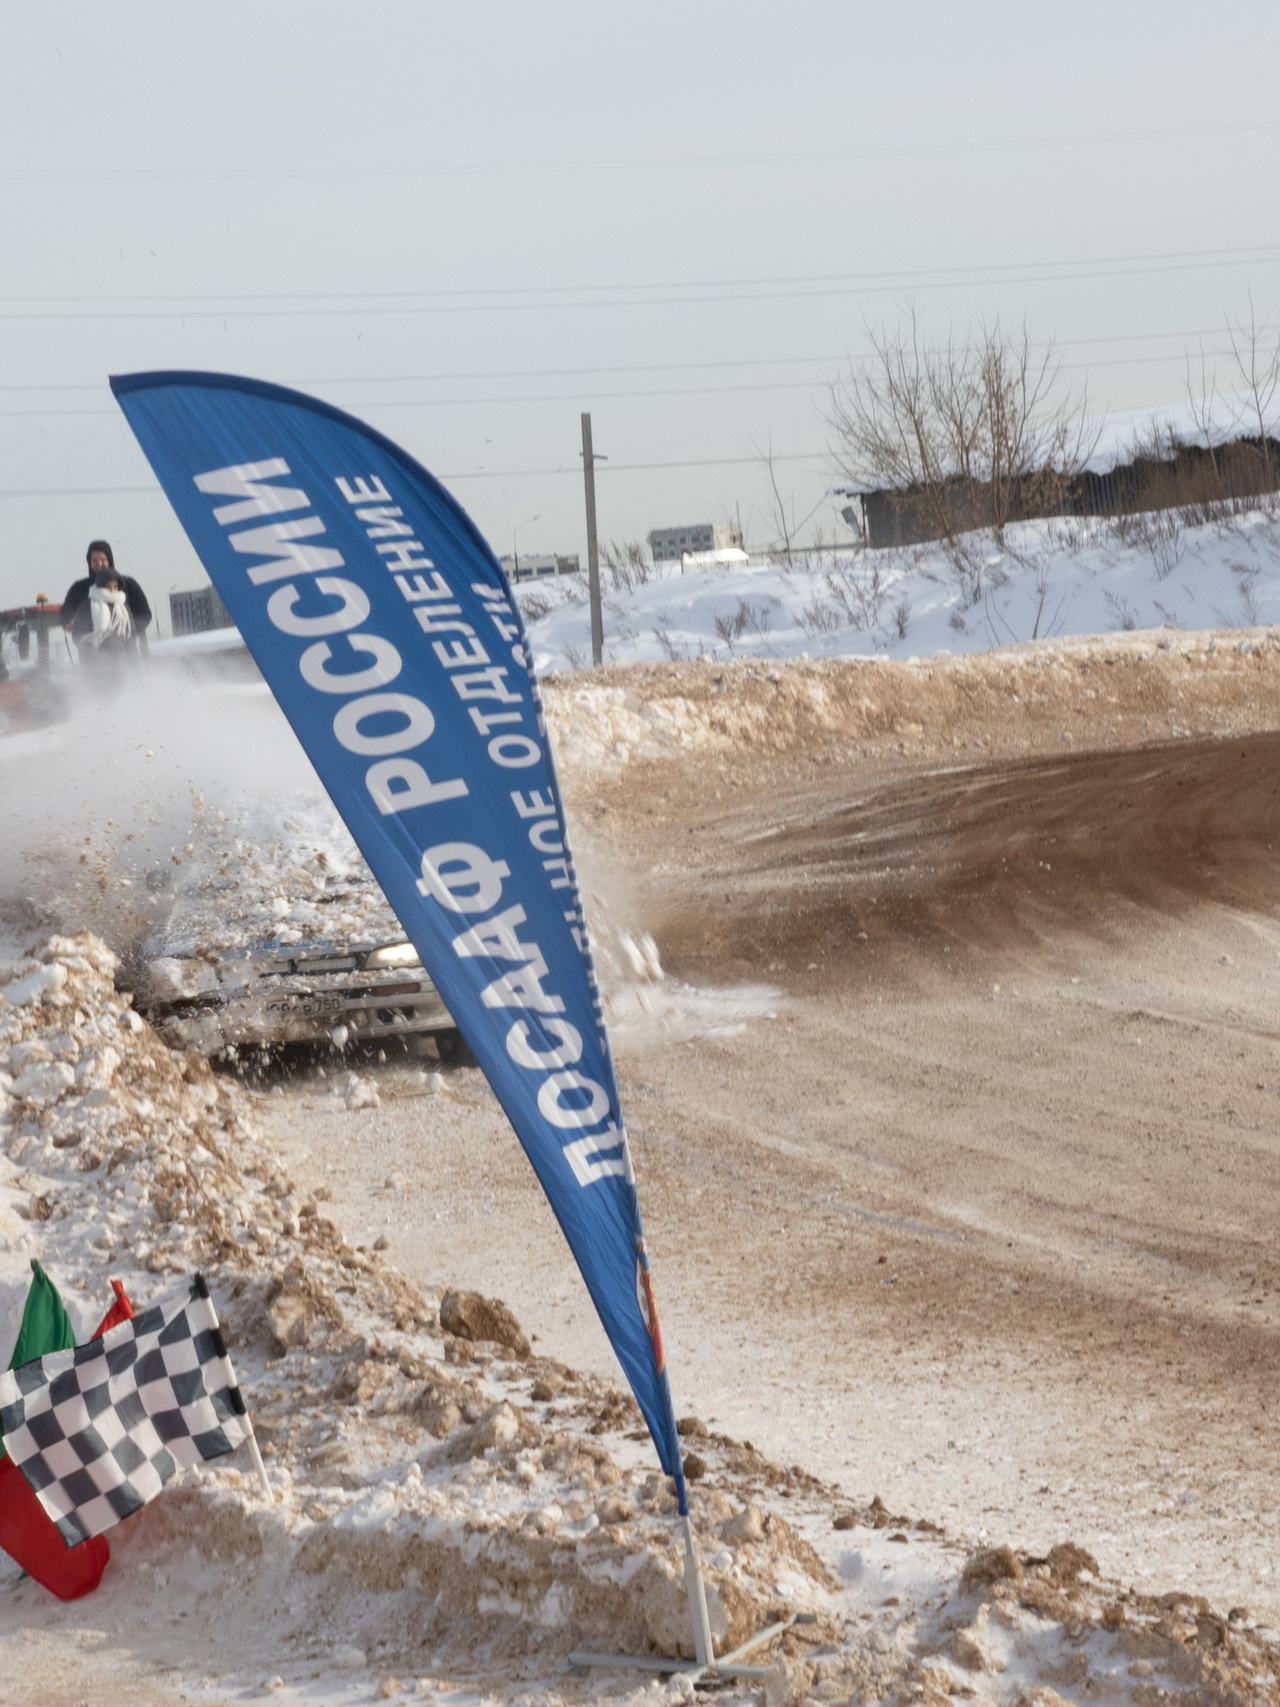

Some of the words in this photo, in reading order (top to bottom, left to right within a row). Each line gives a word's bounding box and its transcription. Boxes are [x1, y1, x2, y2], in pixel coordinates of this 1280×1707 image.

[193, 457, 469, 815] РОССИИ
[334, 474, 542, 768] ОТДЕЛЕНИЕ
[415, 841, 635, 1187] ДОСААФ
